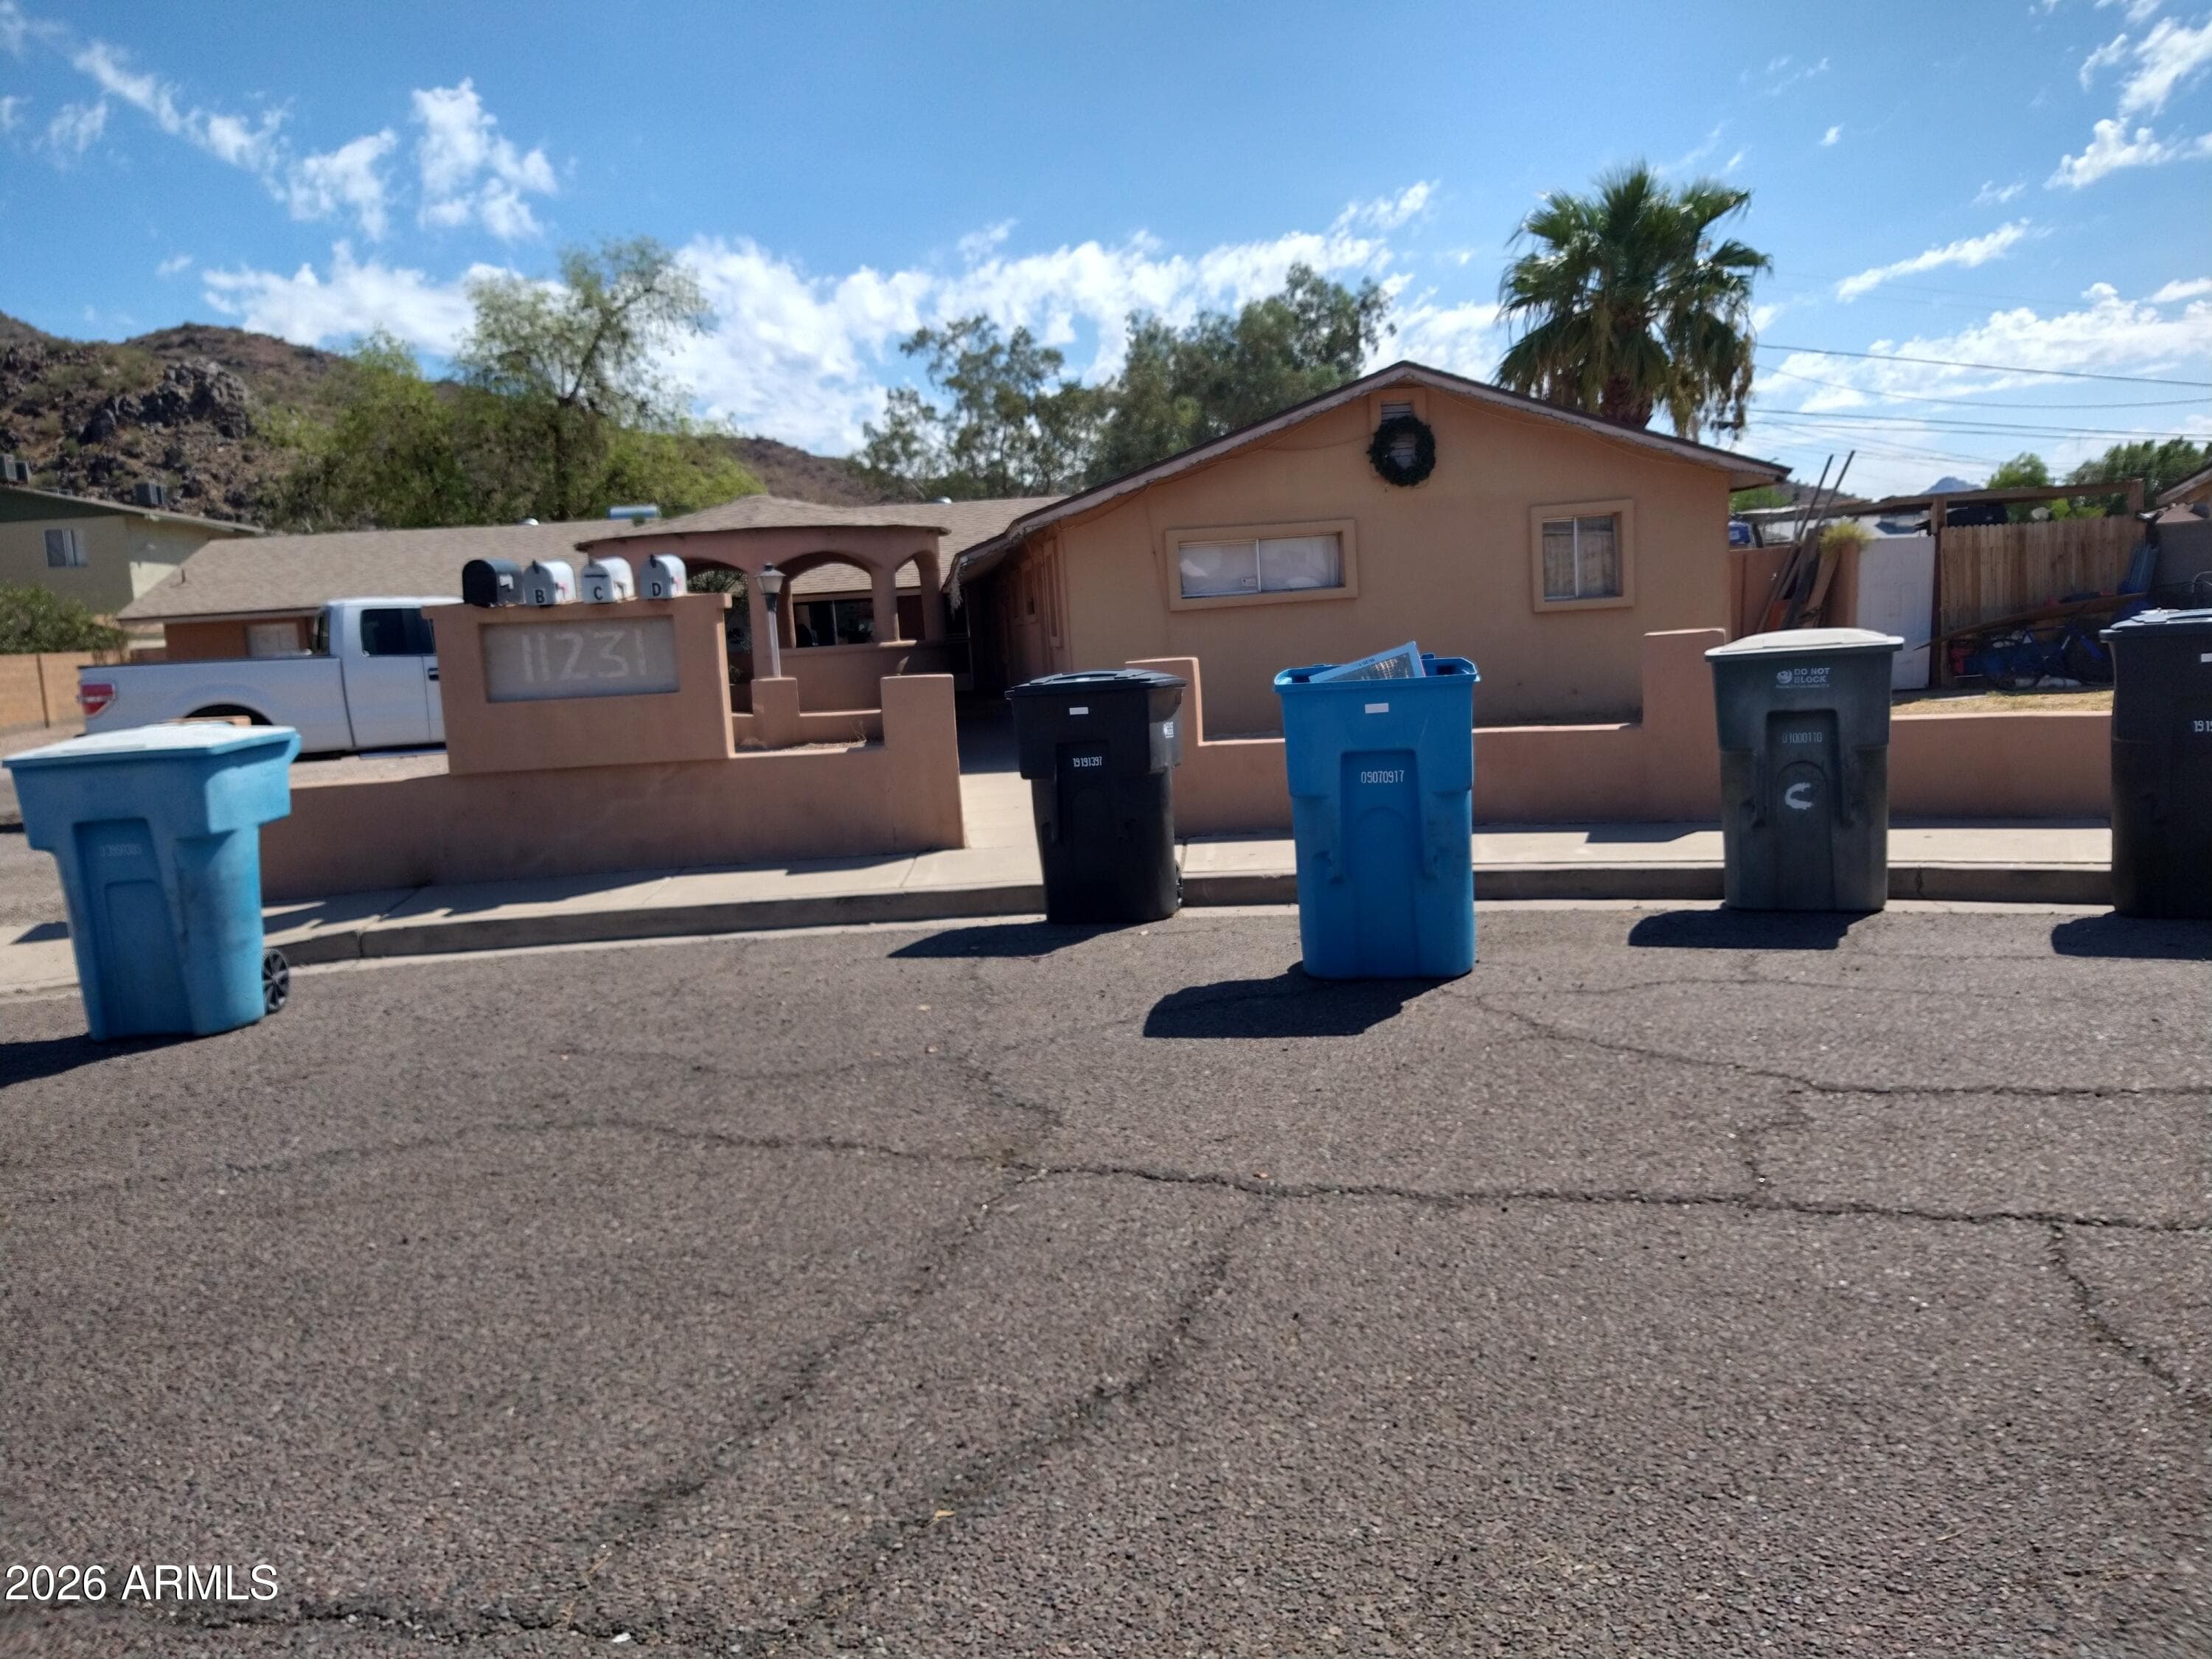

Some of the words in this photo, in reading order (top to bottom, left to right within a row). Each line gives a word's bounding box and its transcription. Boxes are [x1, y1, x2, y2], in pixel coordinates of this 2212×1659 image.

[594, 586, 603, 600] C
[651, 582, 661, 597] D
[535, 590, 545, 604] B
[521, 629, 648, 684] 11231
[1794, 675, 1826, 684] BLOCK
[1360, 770, 1405, 784] 09070917
